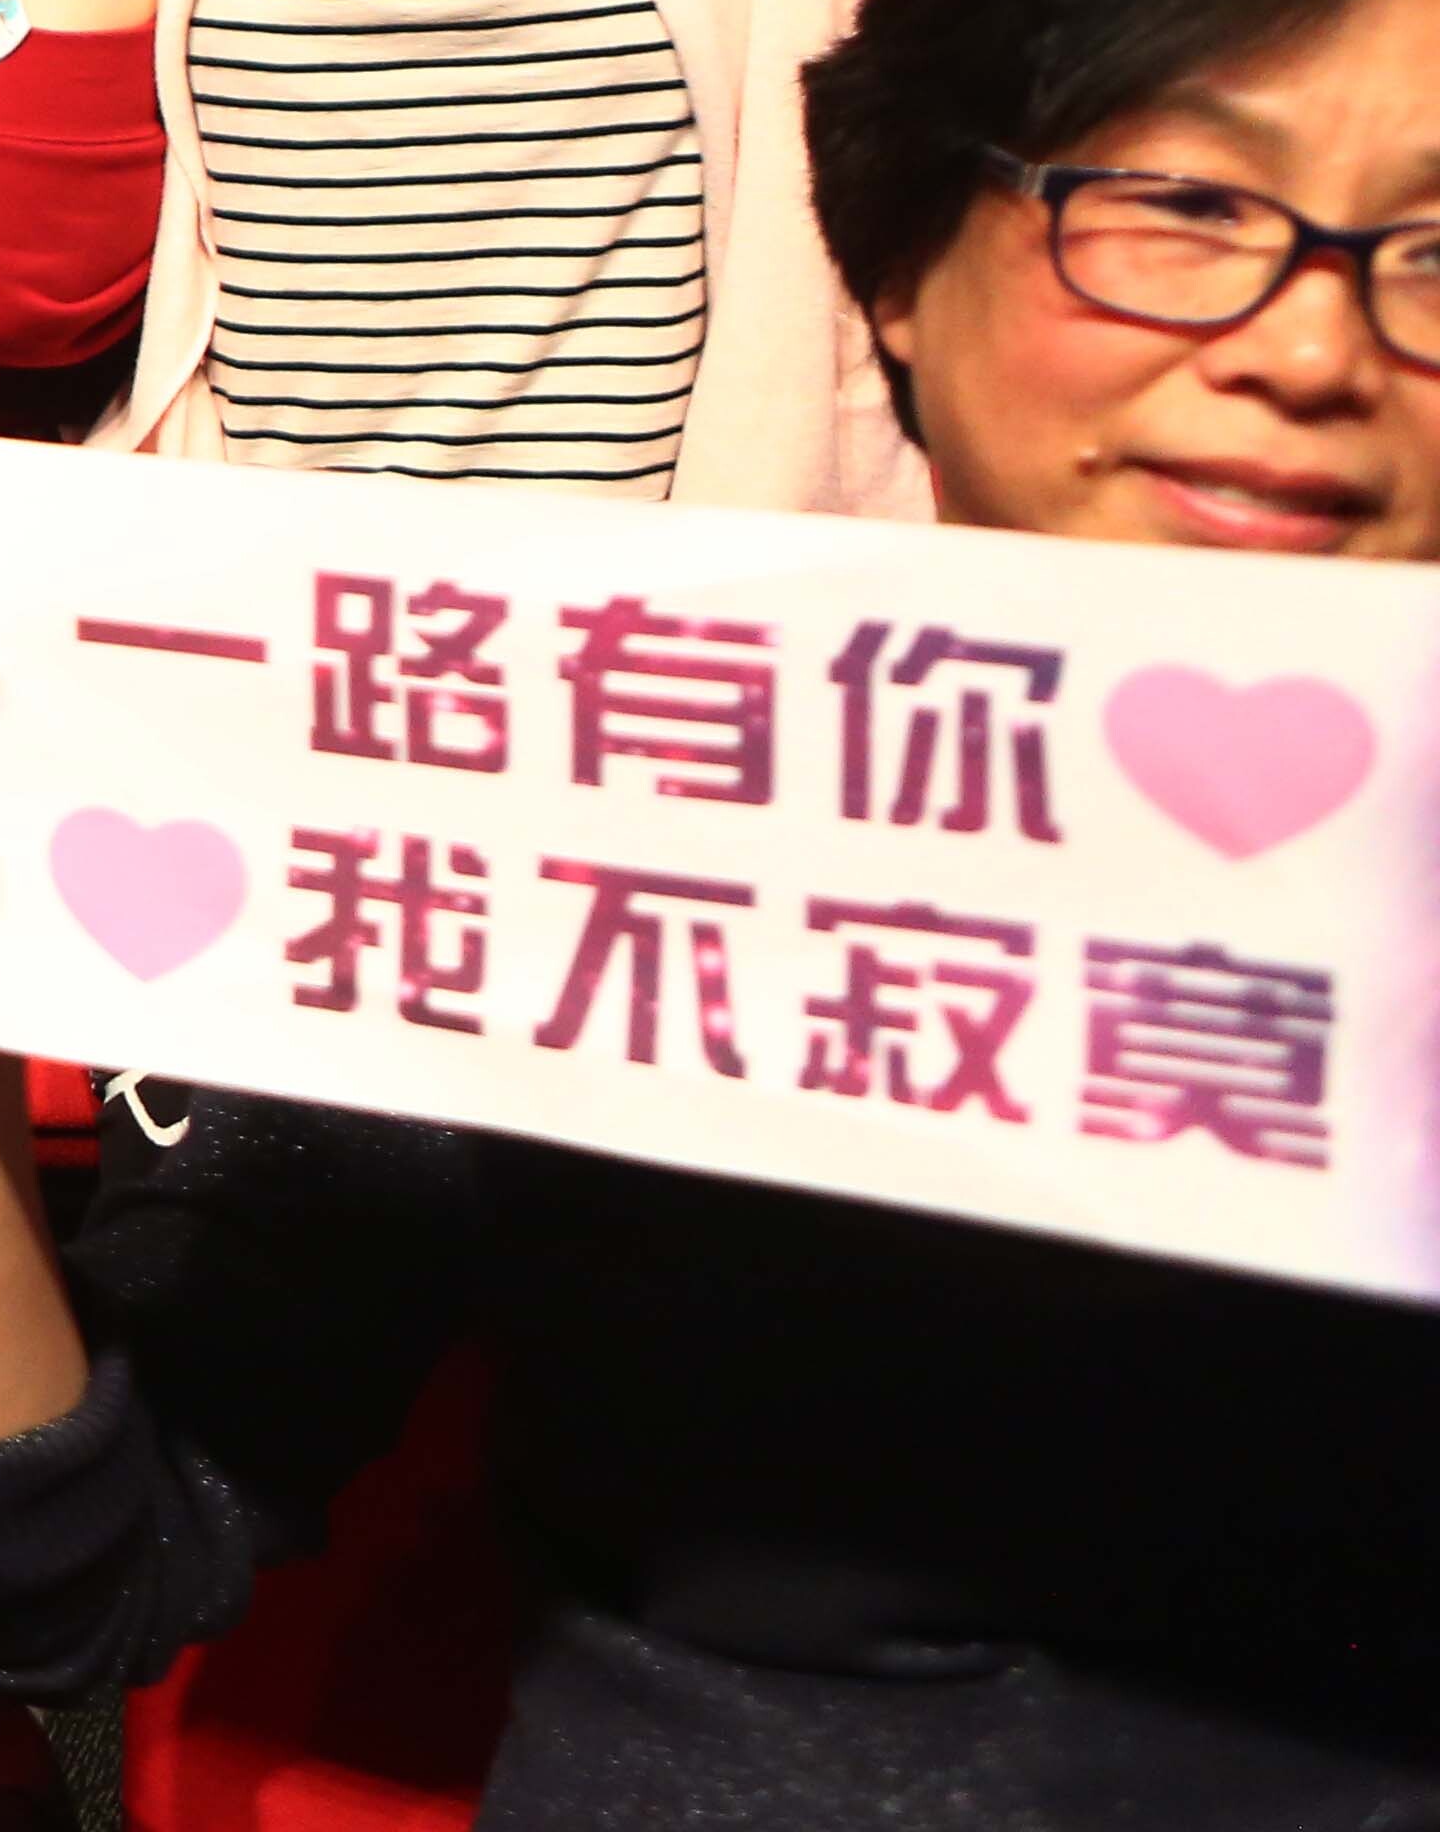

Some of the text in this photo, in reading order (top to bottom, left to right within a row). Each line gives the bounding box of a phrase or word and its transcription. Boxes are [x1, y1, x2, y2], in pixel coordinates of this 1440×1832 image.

[74, 570, 1067, 846] 一路有你
[283, 825, 1336, 1171] 我不寂寞
